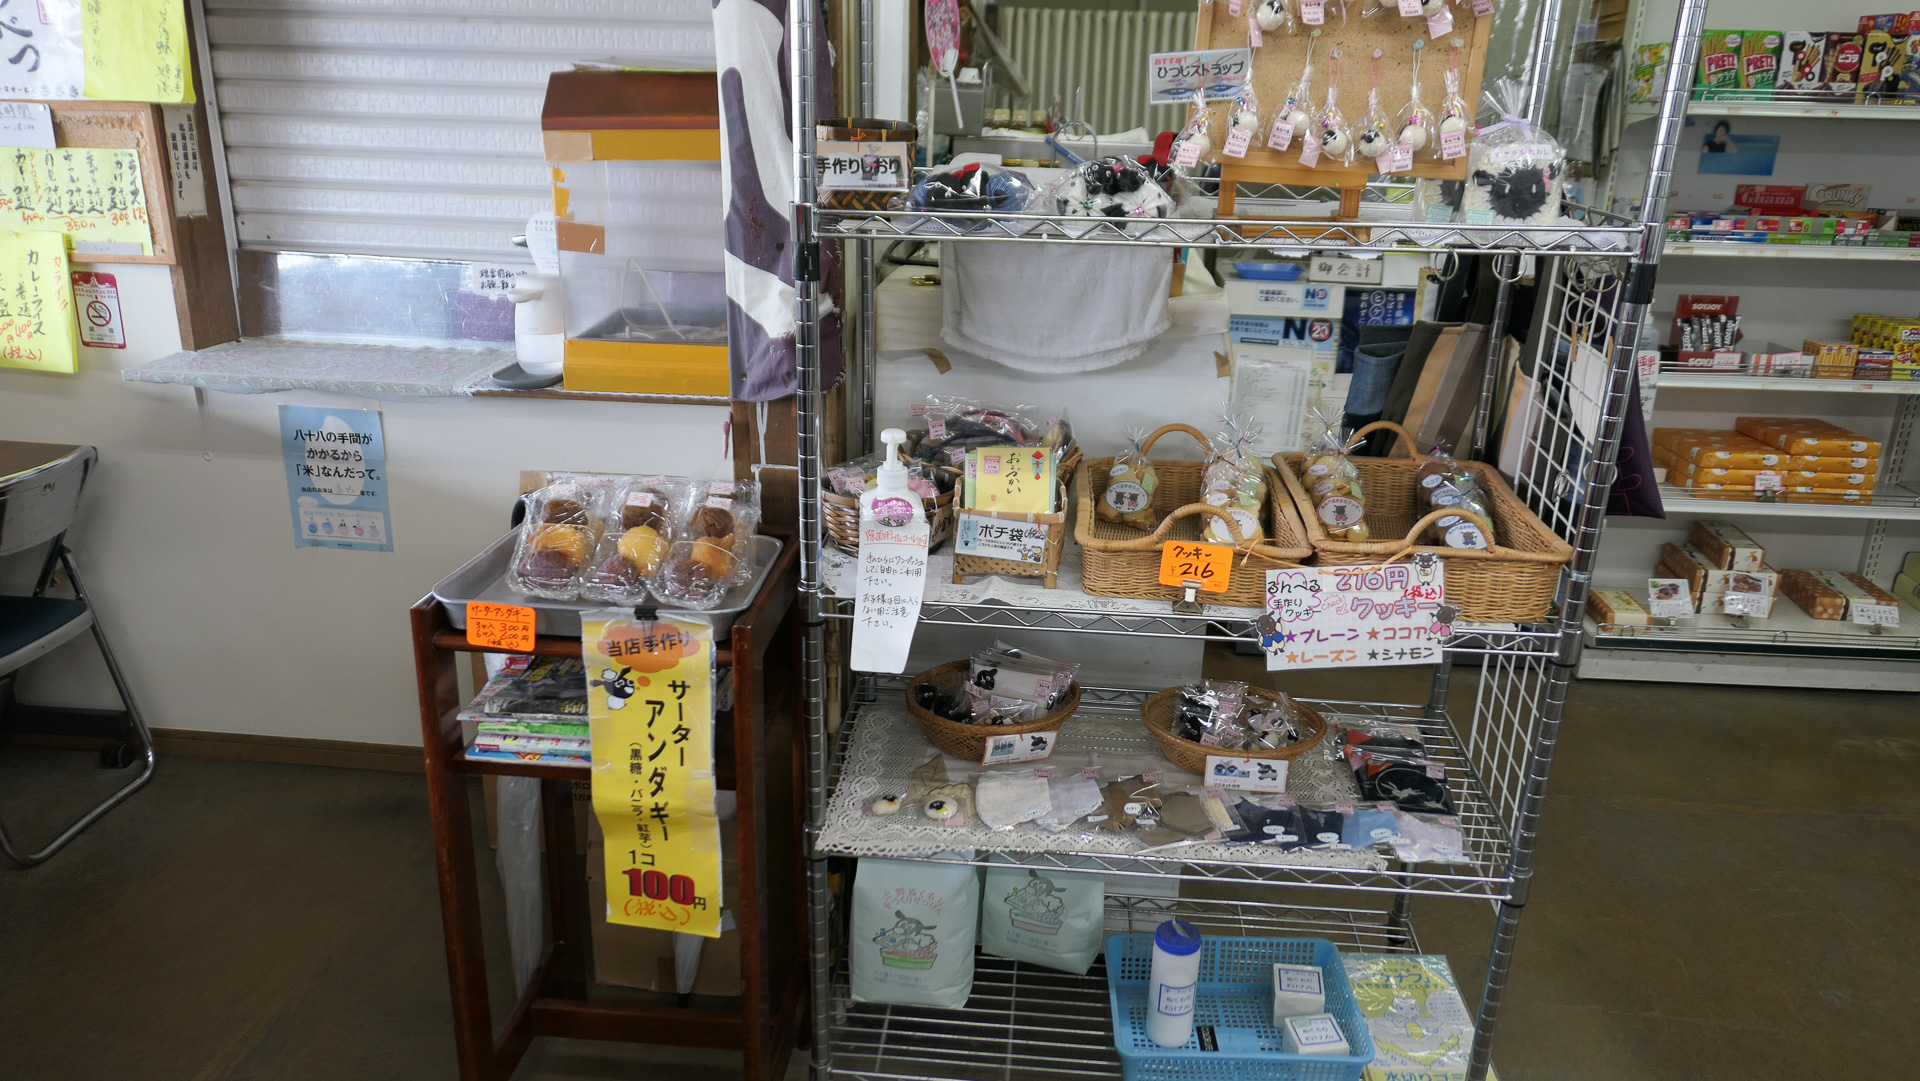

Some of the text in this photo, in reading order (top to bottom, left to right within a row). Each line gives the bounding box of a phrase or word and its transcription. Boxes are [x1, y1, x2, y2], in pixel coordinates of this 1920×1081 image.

[1157, 61, 1245, 79] ひつじストラップ
[1706, 54, 1736, 72] PRETZ
[1745, 54, 1775, 73] PRETZ
[817, 158, 900, 174] 手作りしおり
[1742, 192, 1796, 206] Ghana
[1317, 262, 1370, 277] 御会計
[27, 249, 46, 335] カレーライス
[294, 429, 373, 444] 八十八の手間が
[306, 448, 363, 461] かかるから
[296, 464, 380, 480] 「米」なんだって。
[979, 524, 1024, 542] ポチ袋
[1173, 545, 1212, 560] クッキー
[1268, 579, 1321, 594] るんべる
[1334, 566, 1409, 591] 216円
[1272, 599, 1303, 608] 手作り
[1351, 596, 1439, 620] クッキー
[1285, 608, 1321, 617] クッキー
[1300, 627, 1428, 642] プレーン ココア
[606, 631, 690, 657] 当店手作り
[1301, 648, 1434, 663] レーズン シナモン
[668, 679, 691, 767] サーター
[645, 700, 669, 841] アンダギー
[628, 850, 655, 866] 1コ
